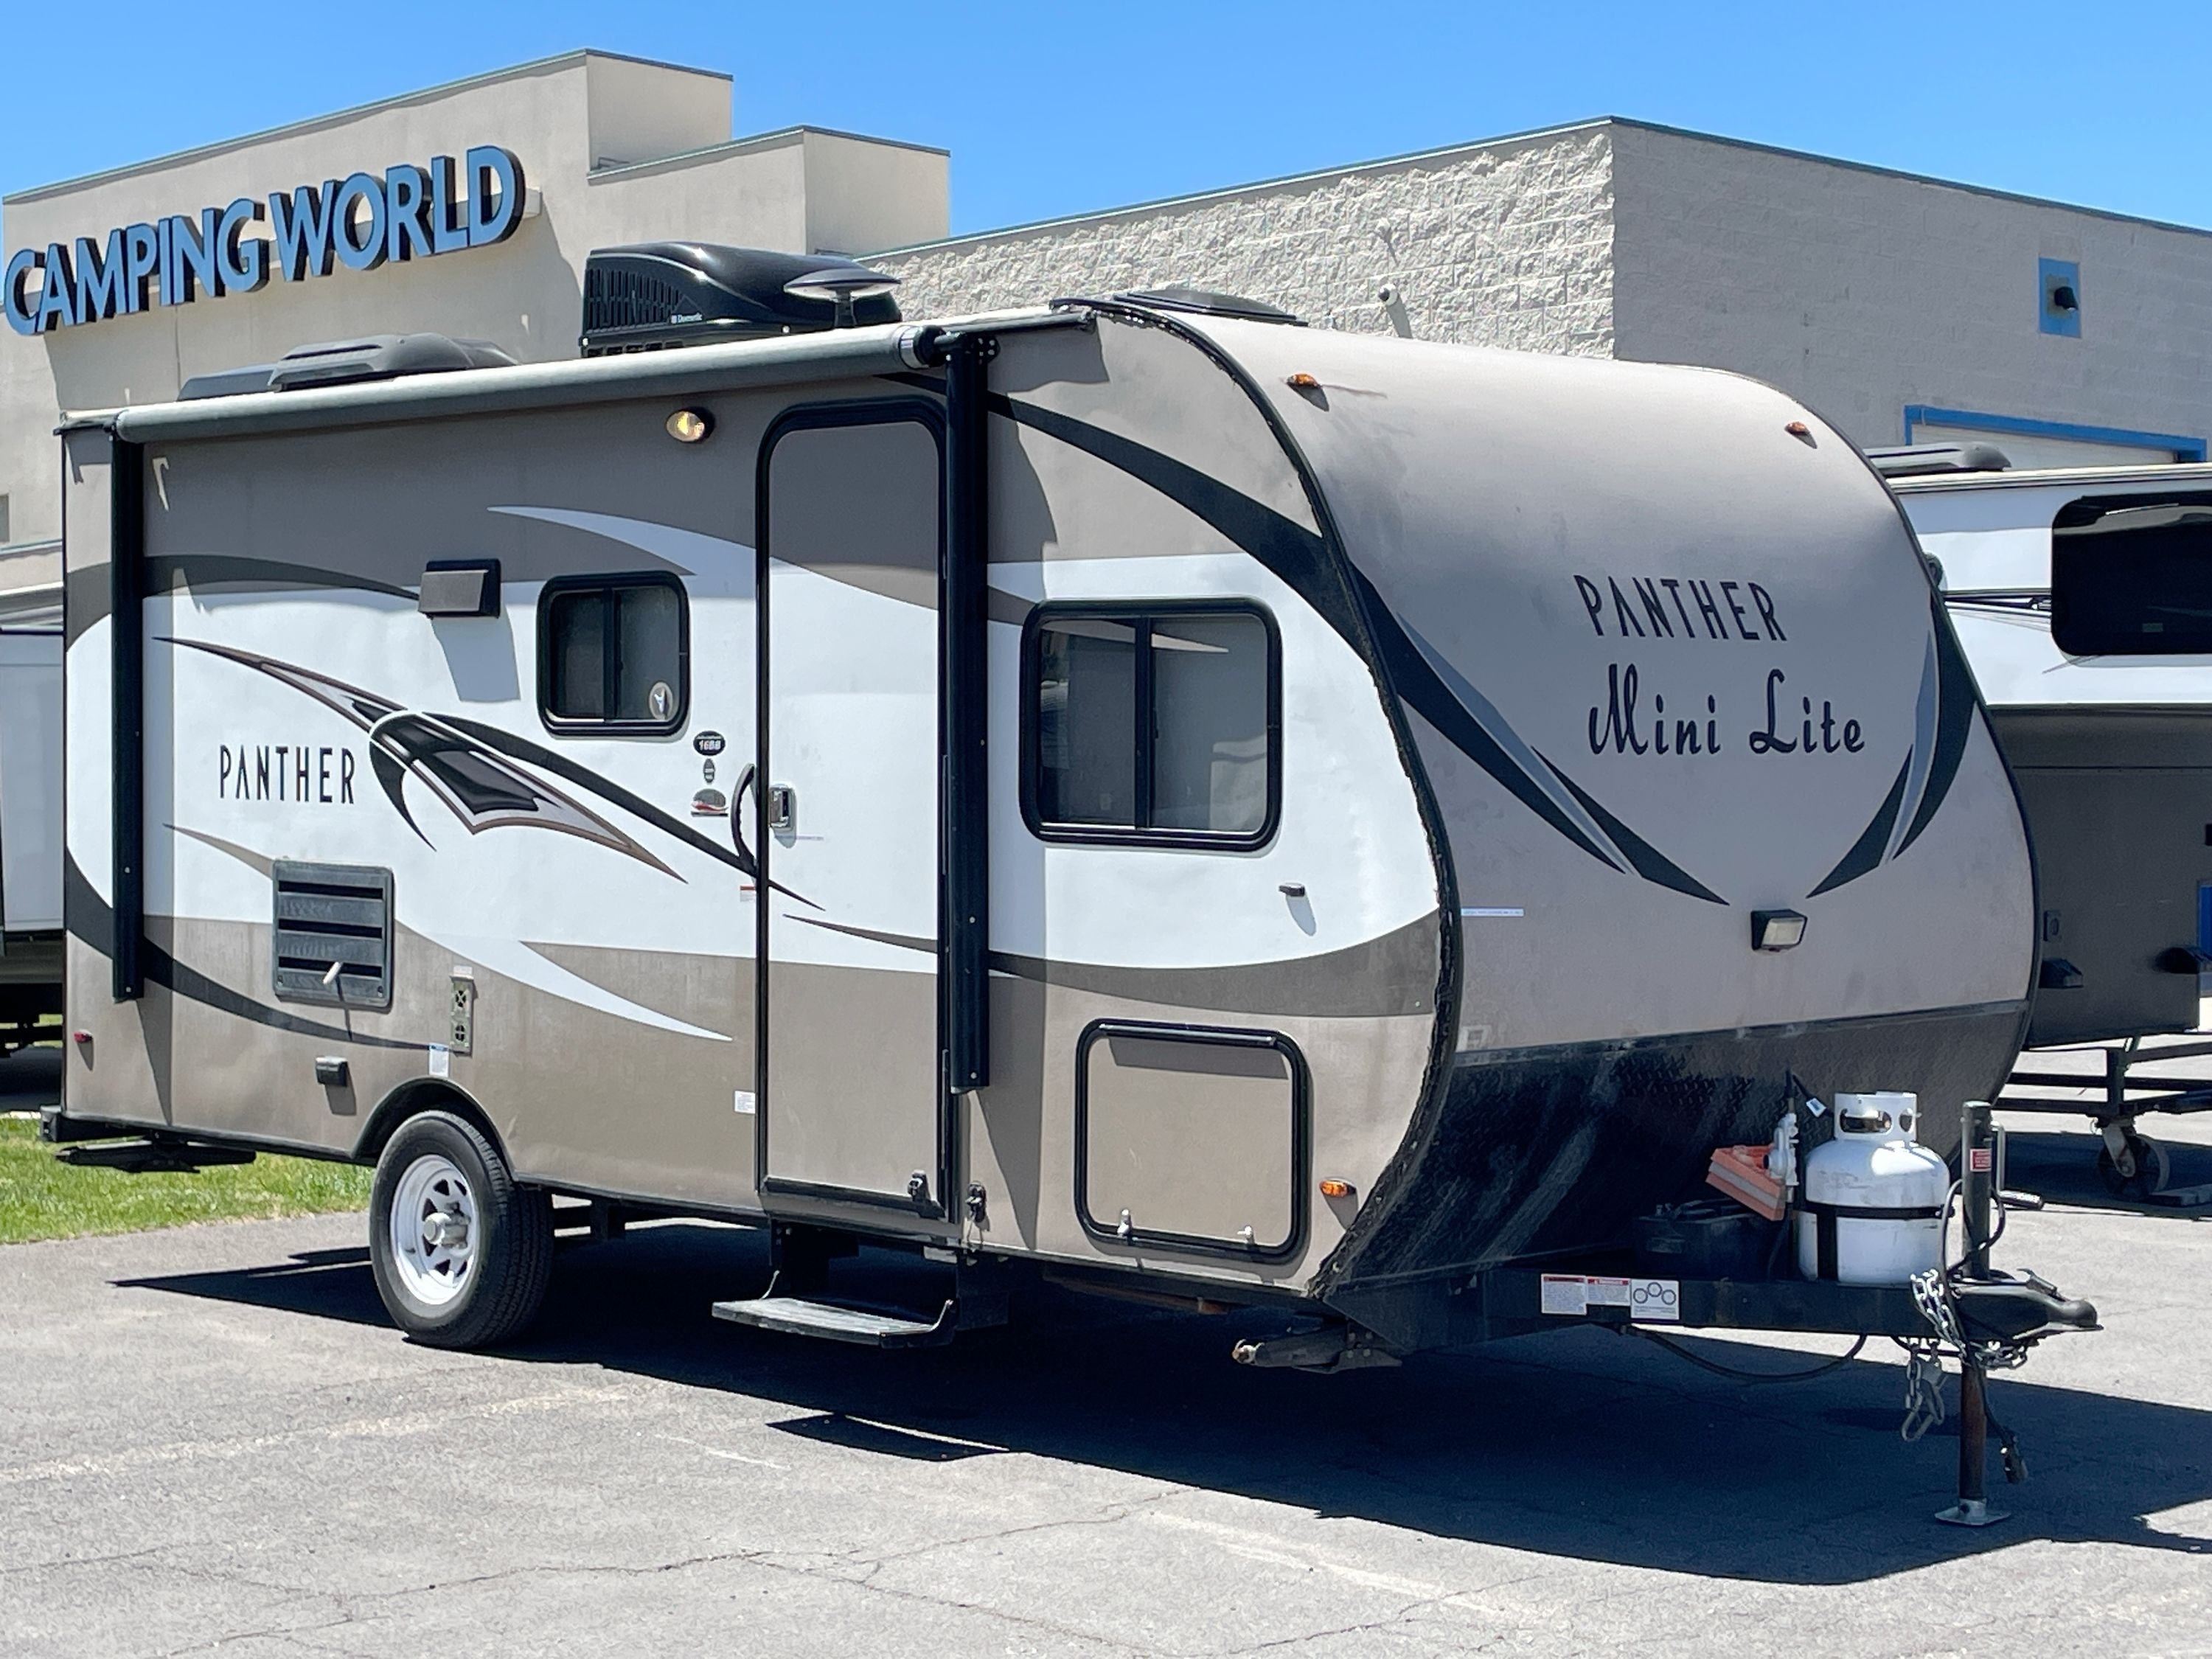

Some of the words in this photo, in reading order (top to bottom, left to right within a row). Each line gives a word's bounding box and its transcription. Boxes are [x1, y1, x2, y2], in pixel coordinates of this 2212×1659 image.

[3, 198, 270, 335] CAMPING
[269, 145, 525, 282] WORLD
[1573, 574, 1787, 641] PANTHER
[1589, 664, 1720, 755] Mini
[1749, 669, 1865, 754] Lite
[220, 745, 355, 804] PANTHER
